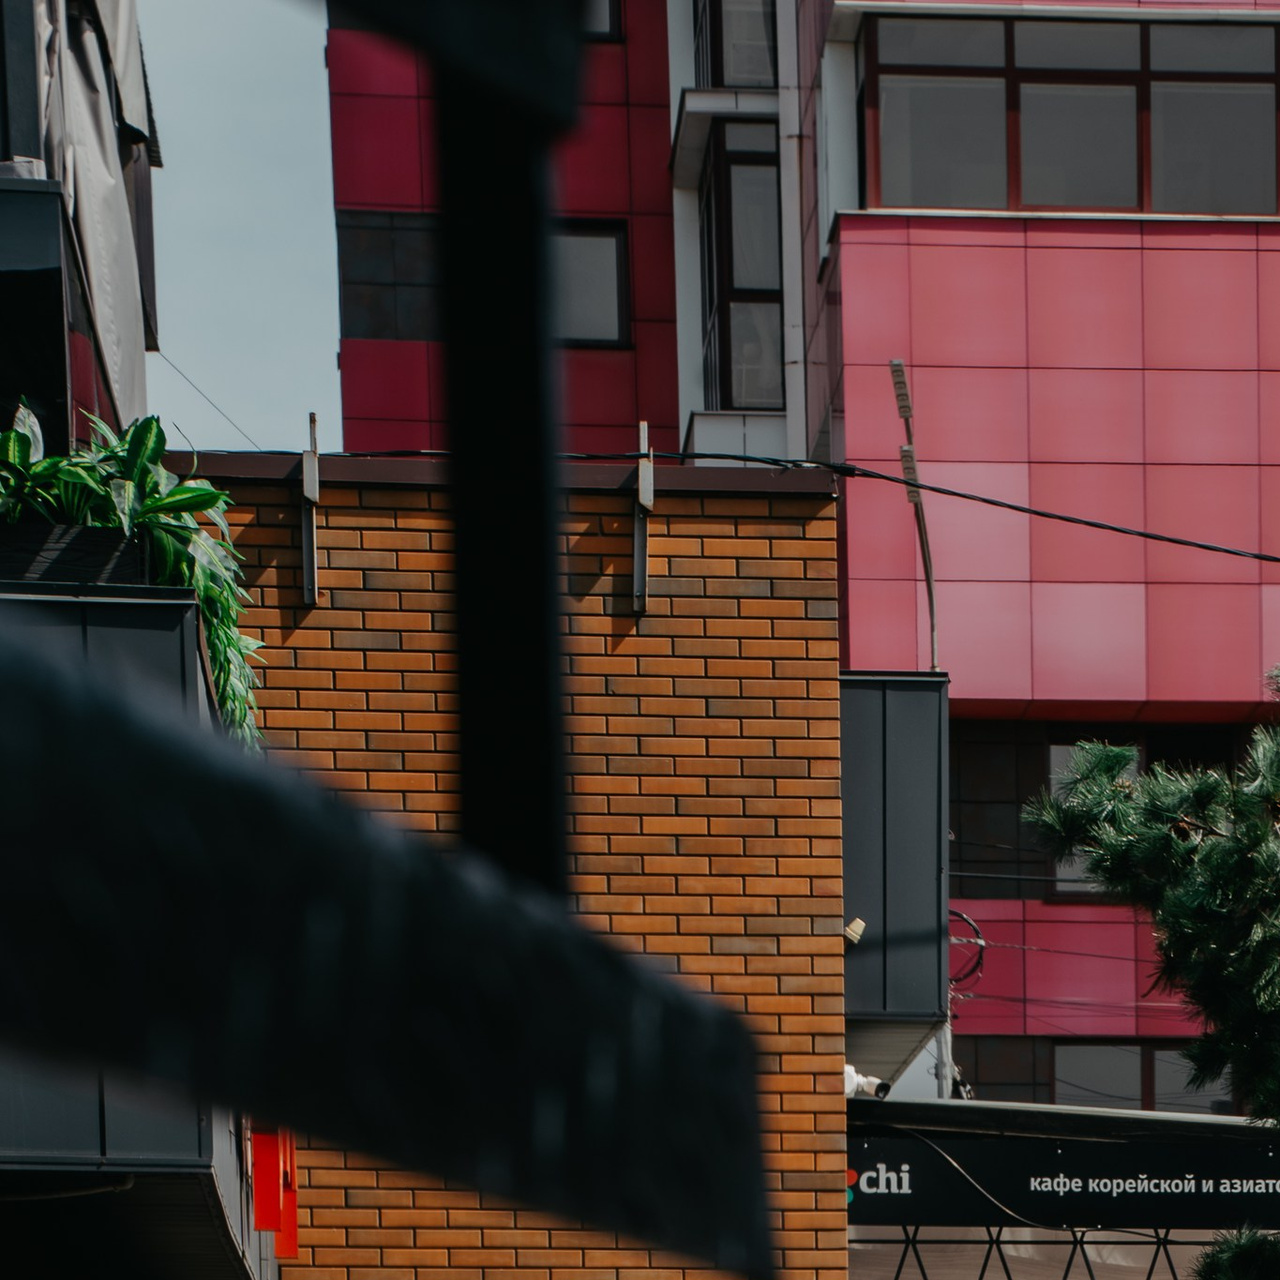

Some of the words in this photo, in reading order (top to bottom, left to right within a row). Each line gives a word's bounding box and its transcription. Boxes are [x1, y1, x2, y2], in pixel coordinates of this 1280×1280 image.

[1029, 1173, 1083, 1196] кафе
[1088, 1173, 1196, 1197] корейской
[1202, 1177, 1214, 1194] и
